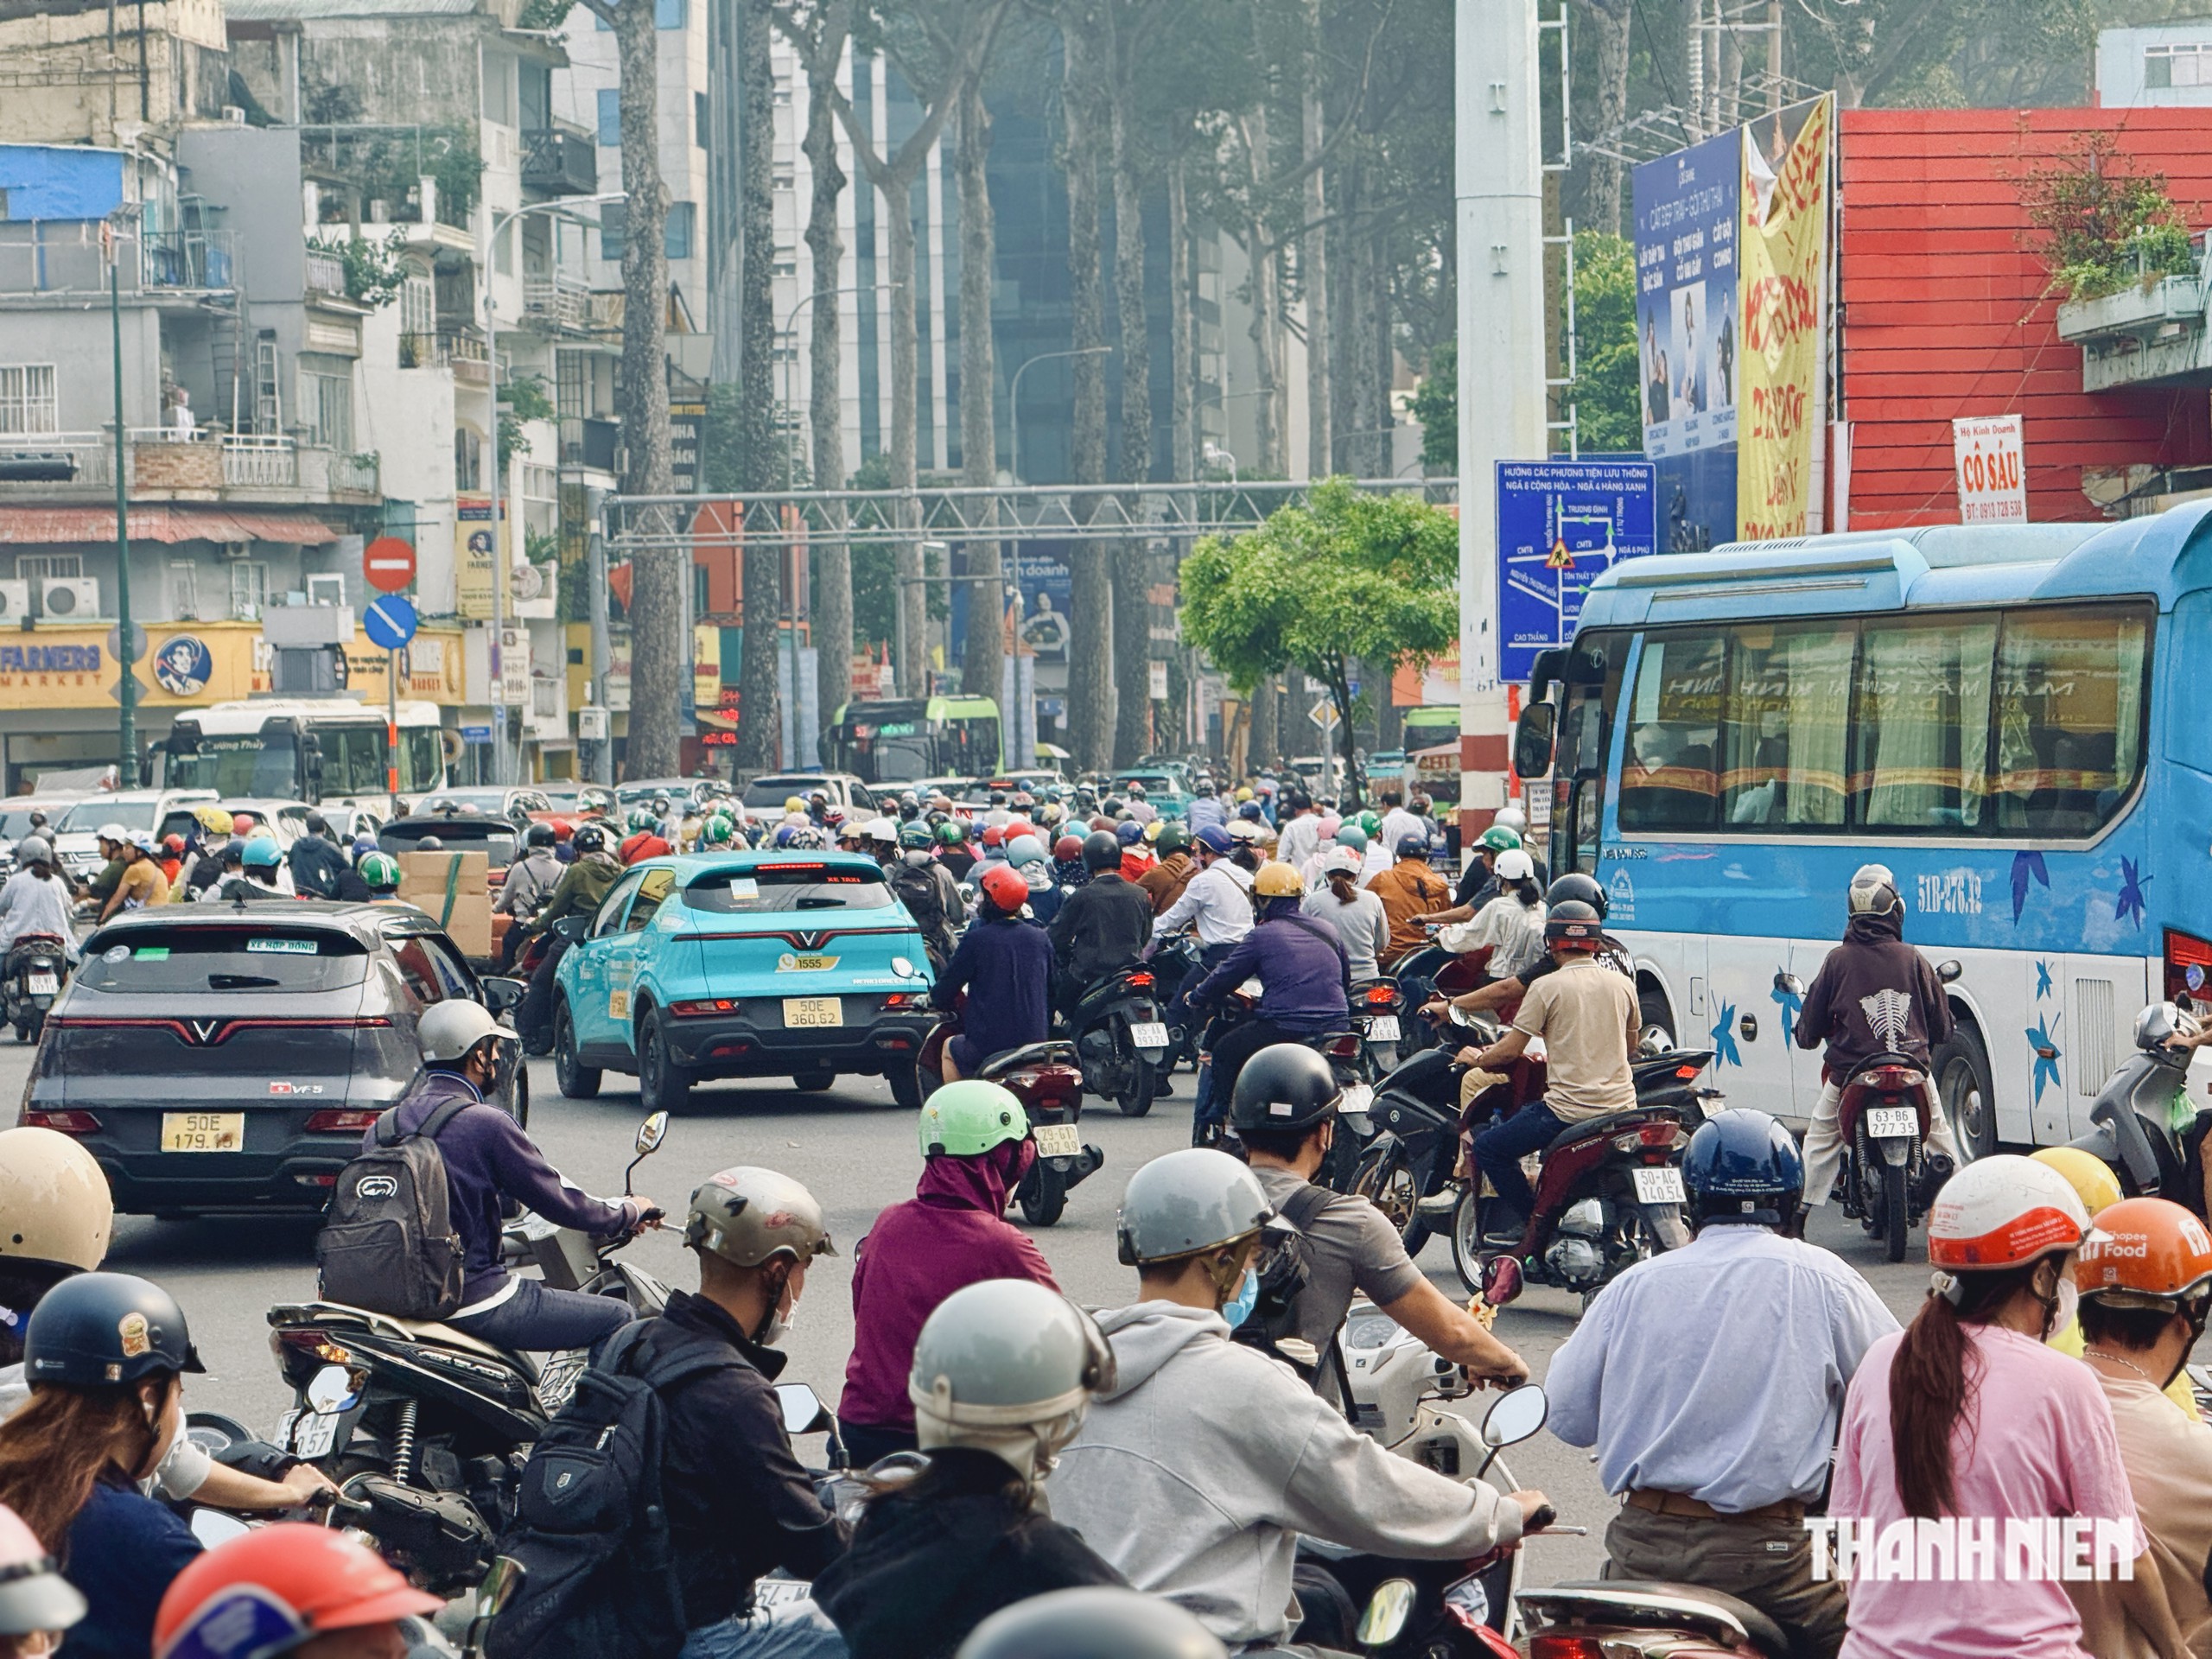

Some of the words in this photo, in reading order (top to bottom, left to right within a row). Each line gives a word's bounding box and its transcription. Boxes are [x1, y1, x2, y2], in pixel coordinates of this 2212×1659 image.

[1534, 467, 1549, 477] CÁC
[1963, 441, 1985, 493] CÔ
[1987, 440, 2018, 491] SÁU
[1624, 483, 1647, 492] XANH
[1027, 563, 1069, 576] doanh
[1514, 633, 1527, 642] CAO
[0, 674, 102, 688] MARKET
[249, 940, 262, 949] XE
[798, 959, 822, 969] 1555
[800, 1000, 824, 1013] 50E
[791, 1013, 836, 1026] 360.62
[291, 1085, 311, 1094] VF
[1875, 1110, 1909, 1122] 63-B6
[187, 1116, 221, 1132] 50E
[1872, 1122, 1915, 1135] 277.35
[1640, 1170, 1676, 1185] 50-AC
[1642, 1185, 1683, 1202] 140.54
[2104, 1243, 2147, 1258] Food
